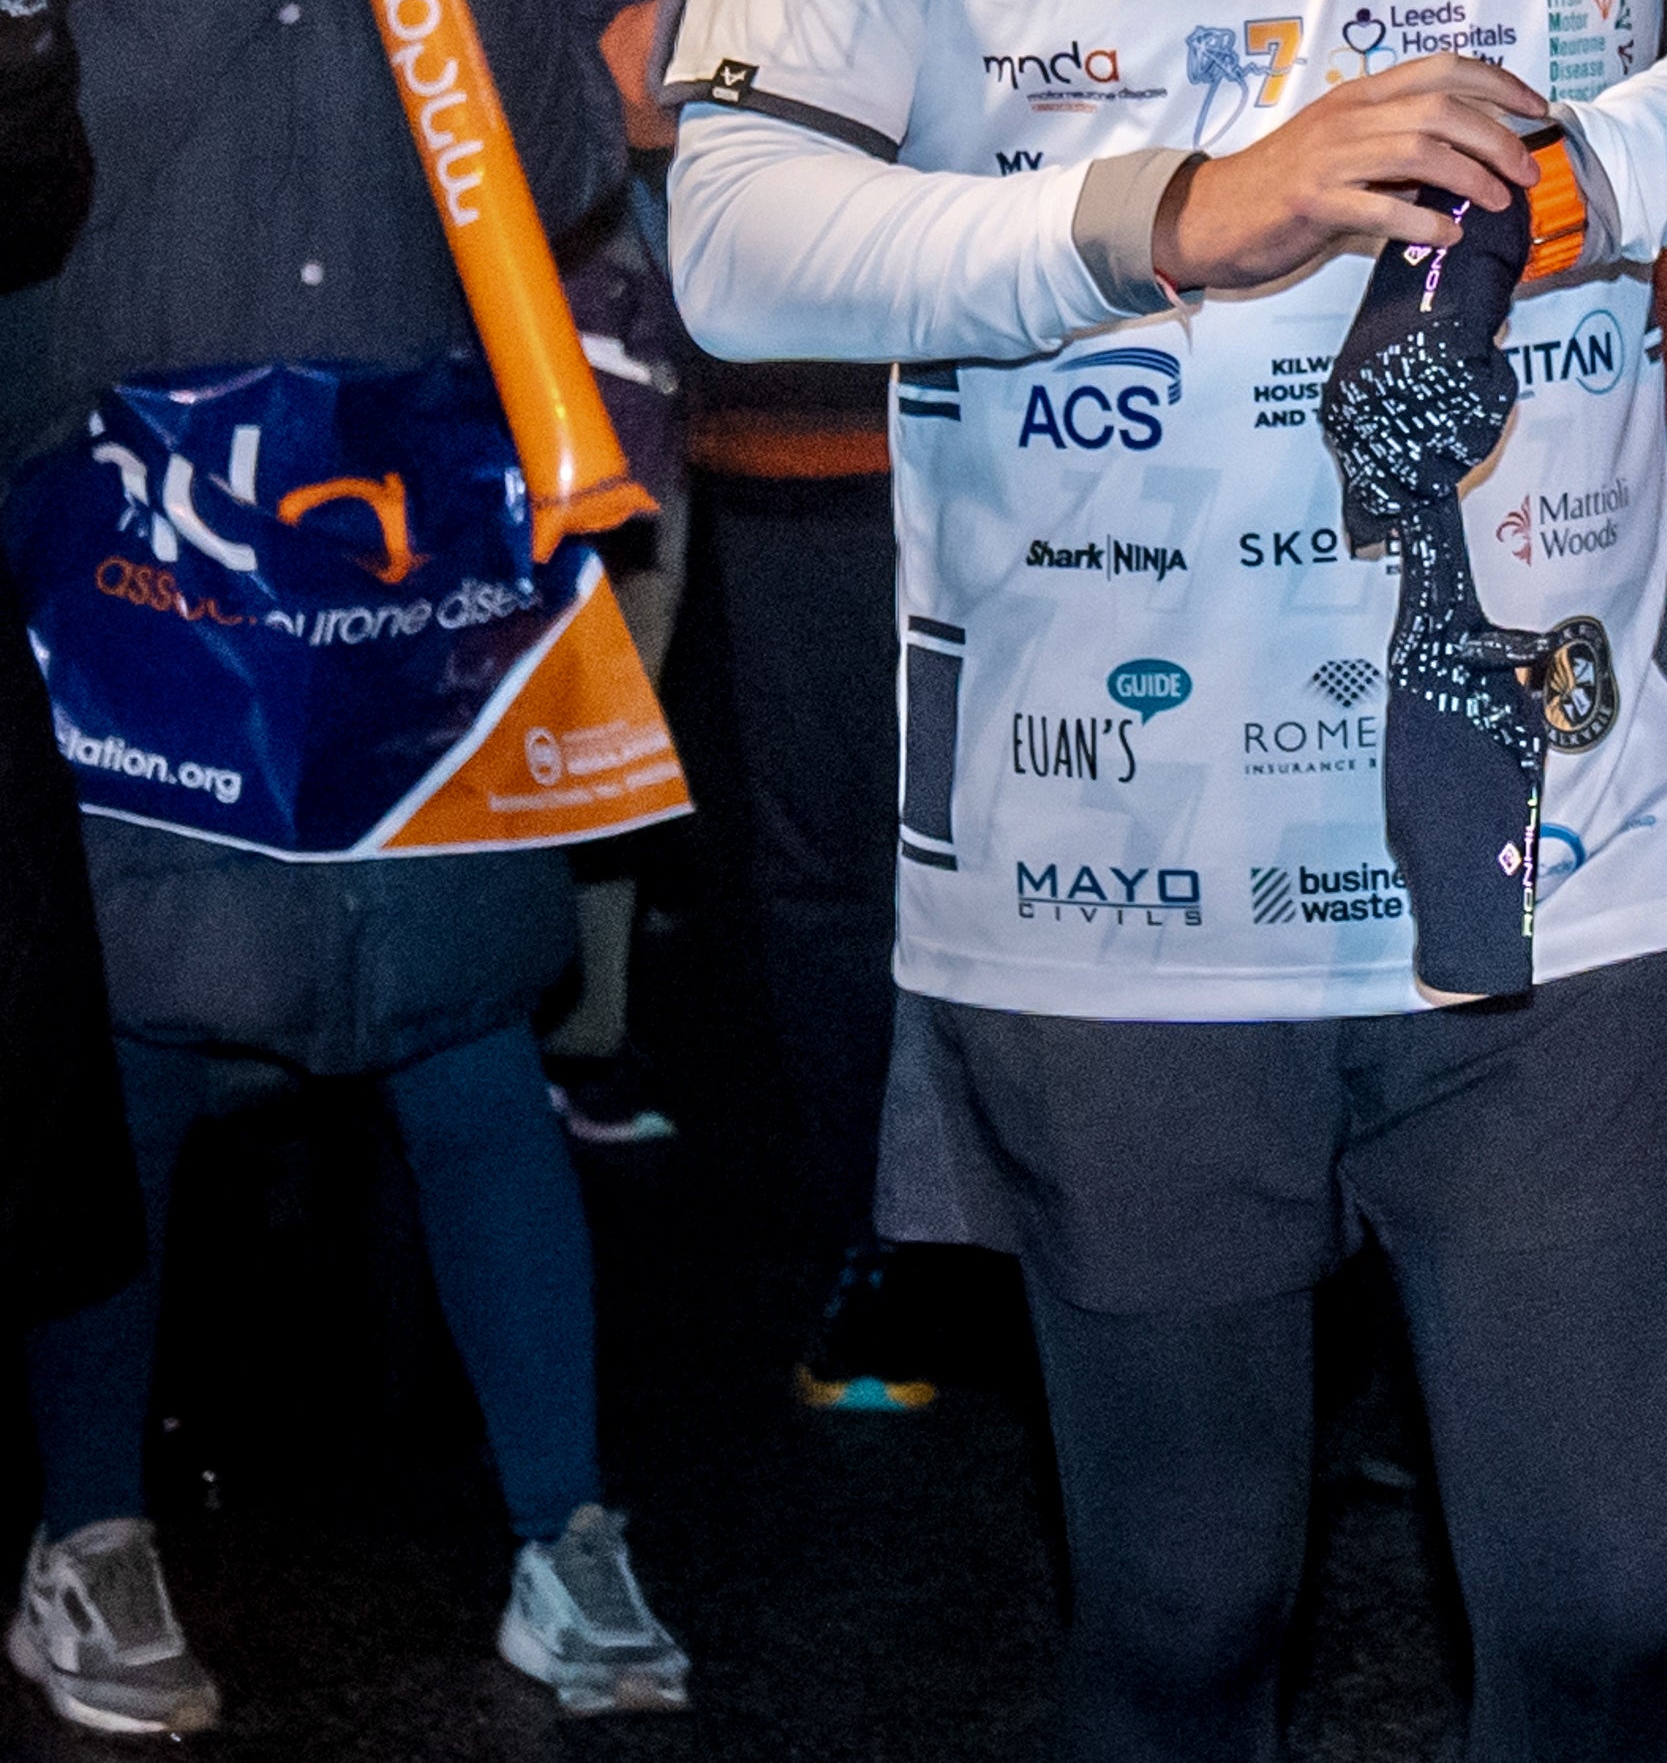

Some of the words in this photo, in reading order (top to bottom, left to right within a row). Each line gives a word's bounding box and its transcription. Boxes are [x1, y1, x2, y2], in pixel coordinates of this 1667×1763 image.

[1391, 1, 1466, 28] Leeds
[1402, 24, 1517, 56] Hospitals
[984, 40, 1119, 89] mnda
[1244, 17, 1303, 108] 7
[1271, 356, 1334, 376] KILW
[1254, 383, 1320, 402] HOUS
[1017, 385, 1164, 451] ACS
[1254, 409, 1306, 428] AND
[1539, 480, 1630, 525] Mattioli
[1239, 528, 1339, 568] SKO
[1540, 520, 1618, 560] Woods
[1115, 672, 1182, 698] GUIDE
[1013, 712, 1136, 783] EUAN'S
[1245, 759, 1356, 775] INSURANCE
[1016, 861, 1200, 904] MAYO
[1299, 862, 1407, 896] busine
[1018, 904, 1202, 927] CIVILS
[1301, 893, 1403, 924] waste
